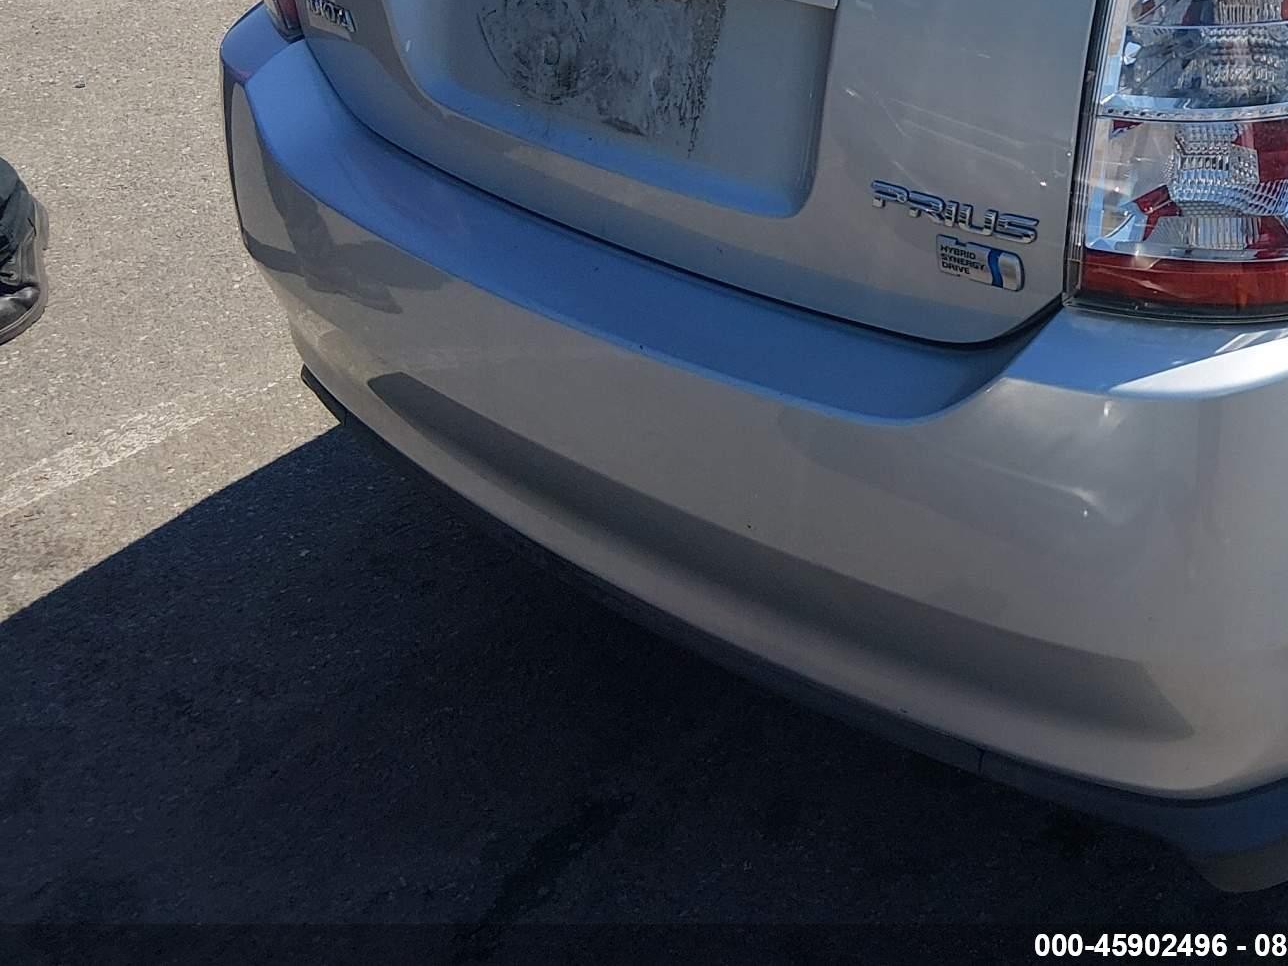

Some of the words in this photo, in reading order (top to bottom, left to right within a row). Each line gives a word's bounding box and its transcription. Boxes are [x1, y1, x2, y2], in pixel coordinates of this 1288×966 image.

[871, 179, 1040, 244] PRIUS
[940, 244, 976, 260] HYBRID
[940, 252, 986, 271] SYNERGY
[941, 261, 971, 274] DRIVE
